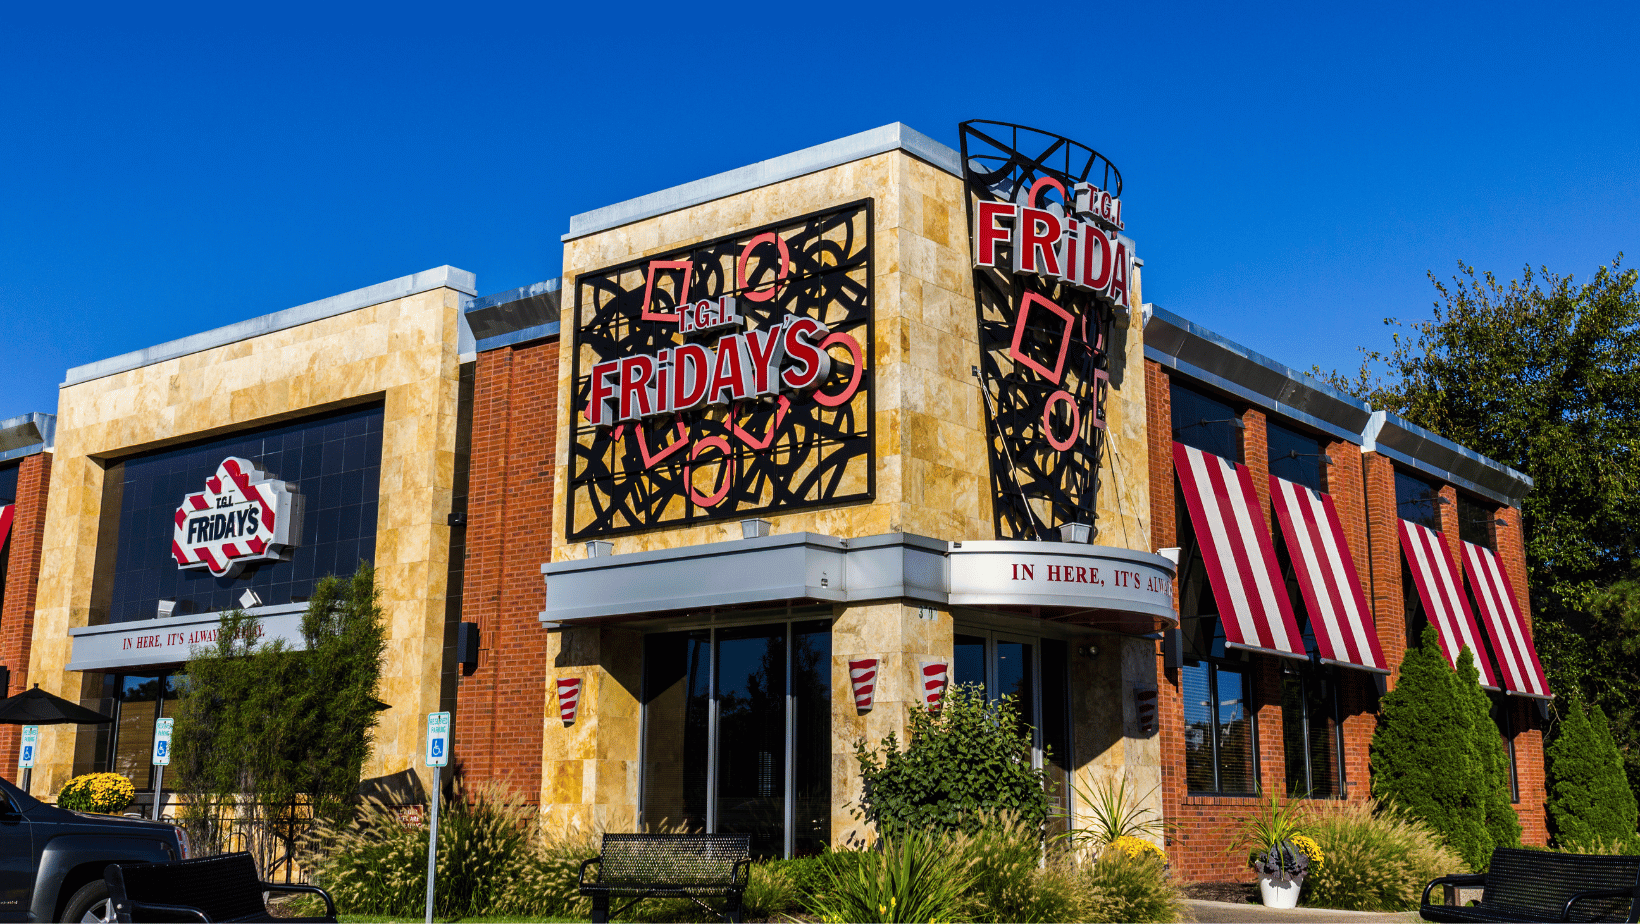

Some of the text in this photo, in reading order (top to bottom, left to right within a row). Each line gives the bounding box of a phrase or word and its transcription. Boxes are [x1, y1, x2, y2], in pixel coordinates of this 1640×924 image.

[1086, 183, 1125, 230] T.G.I.
[977, 199, 1133, 309] FRiDA
[675, 295, 733, 334] T.G.I.
[215, 495, 234, 509] T.G.I.
[1011, 563, 1035, 581] IN
[1047, 564, 1105, 587] HERE,
[1114, 569, 1141, 590] IT'S
[122, 637, 134, 650] IN
[136, 634, 163, 649] HERE,
[167, 632, 185, 647] IT'S
[187, 628, 221, 644] ALWAY
